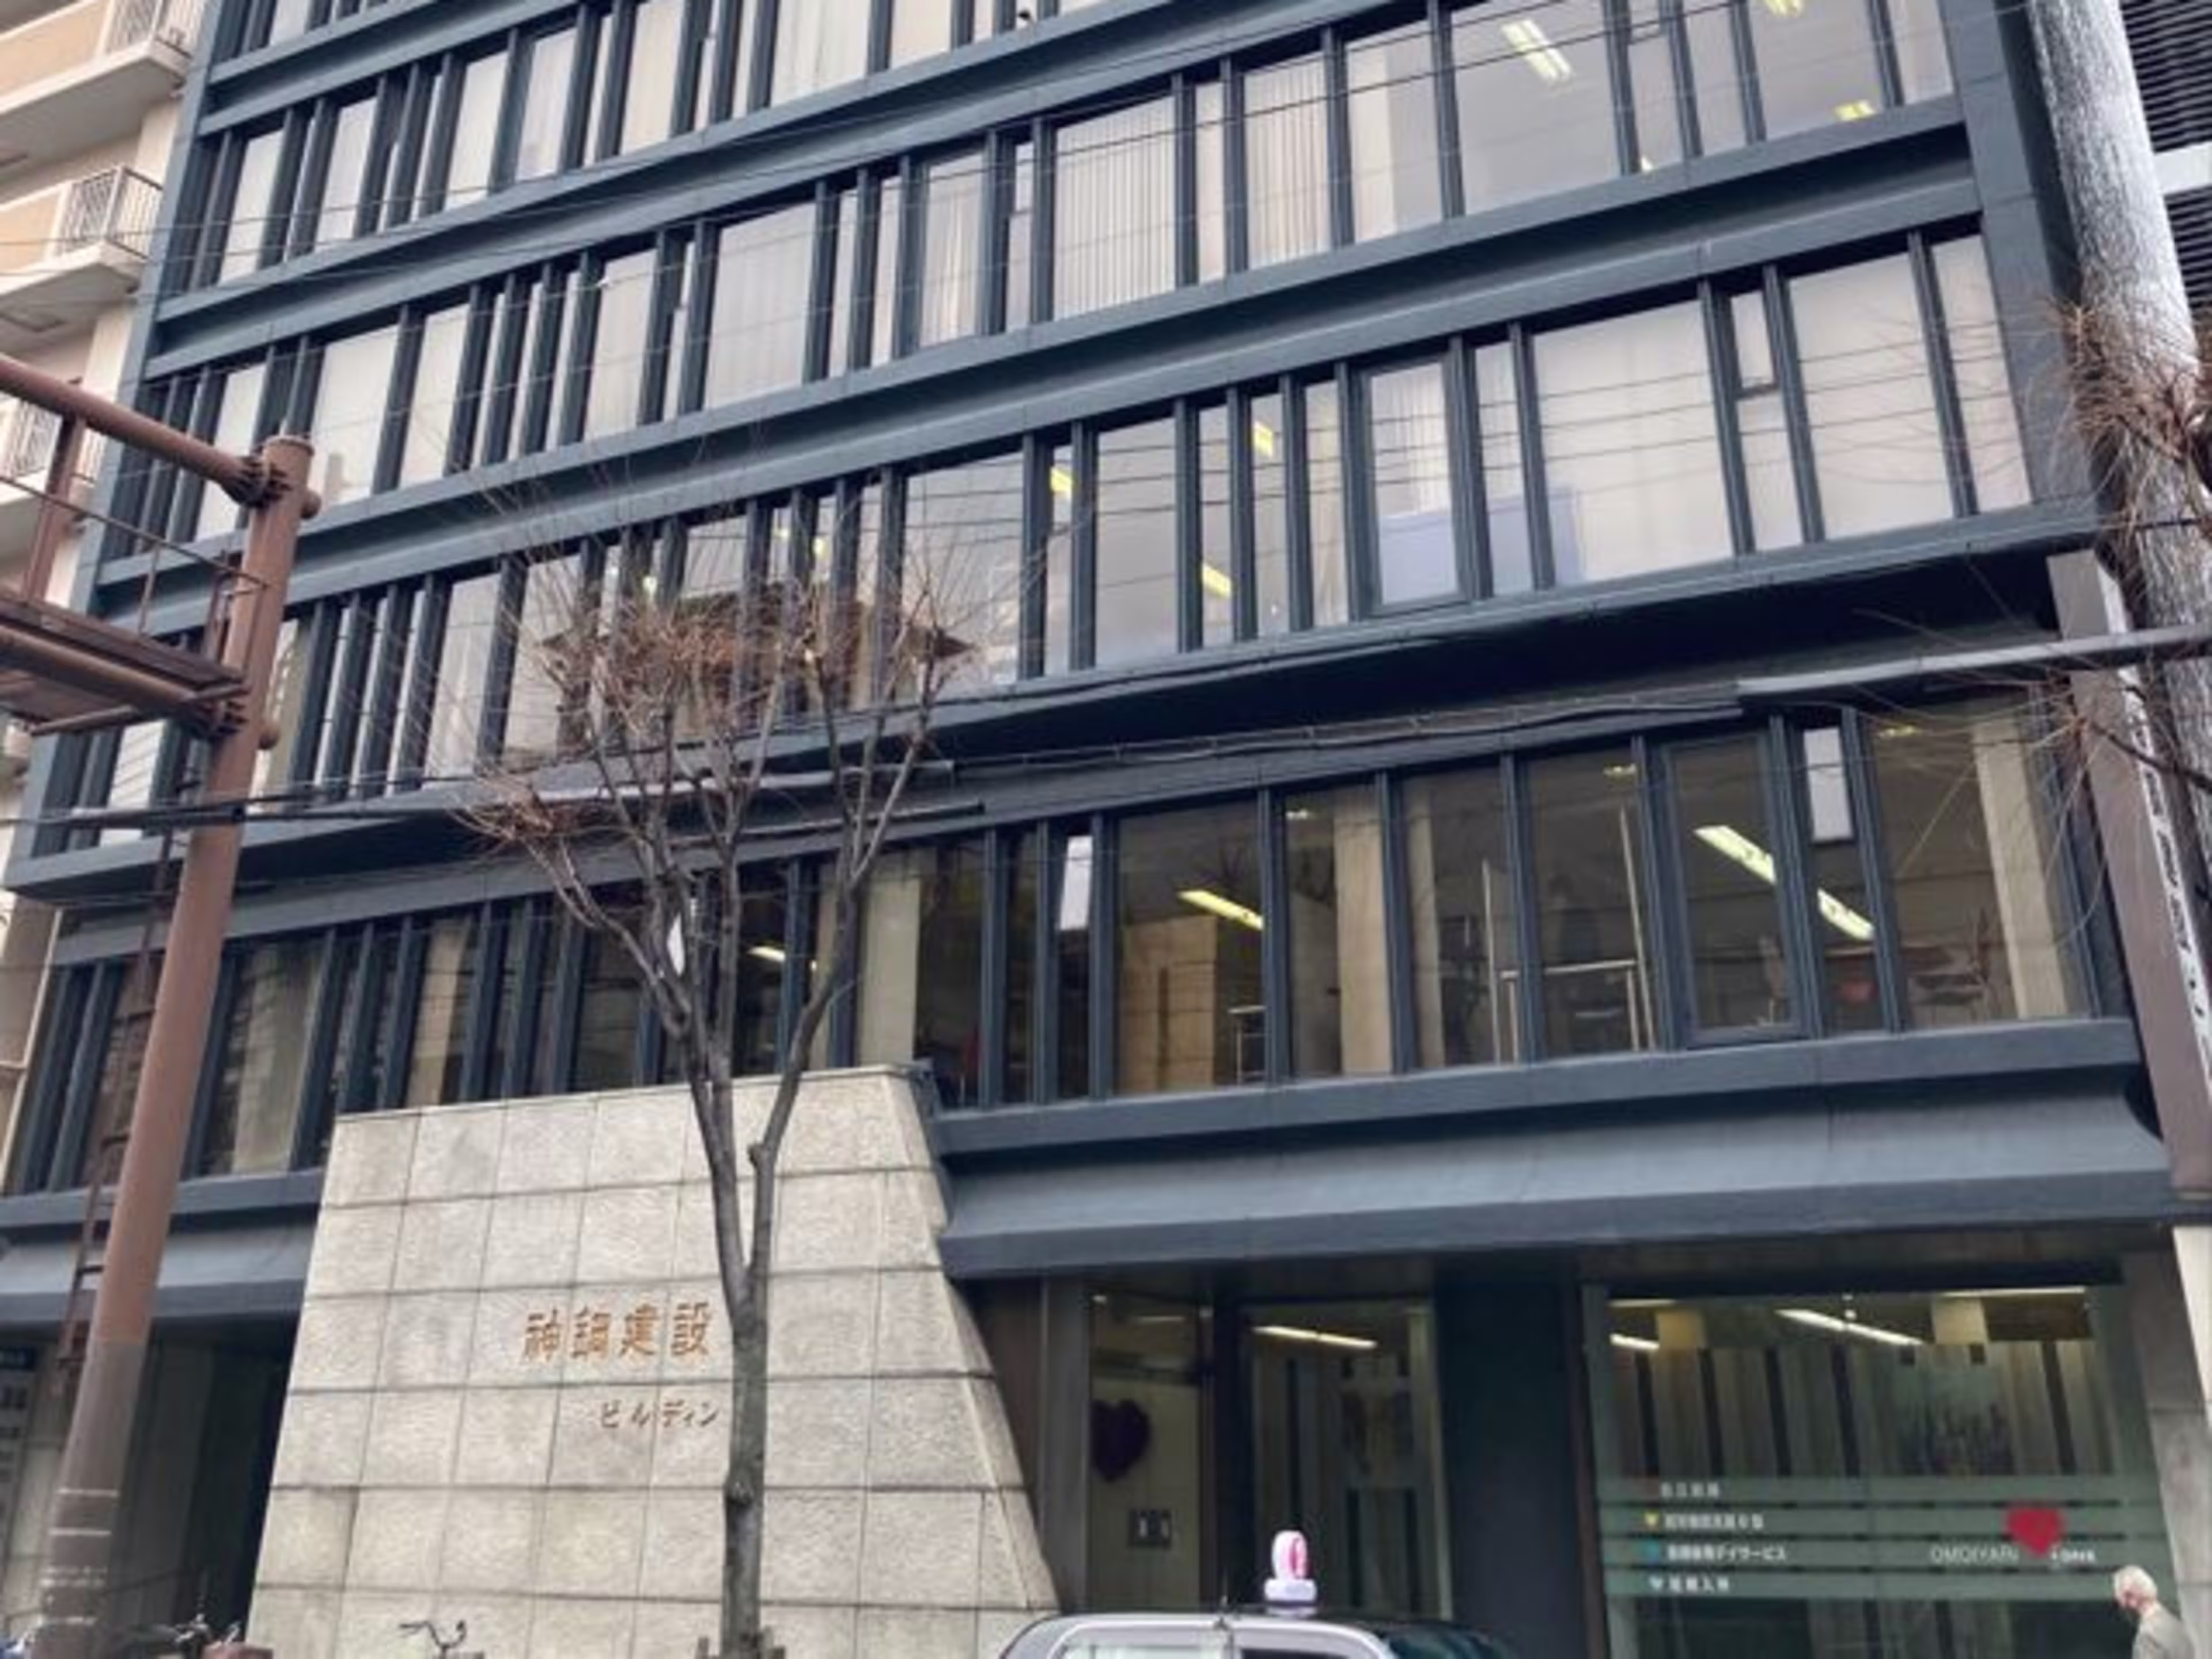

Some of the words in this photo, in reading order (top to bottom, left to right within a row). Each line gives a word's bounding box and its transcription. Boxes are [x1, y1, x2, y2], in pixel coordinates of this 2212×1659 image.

[601, 1400, 719, 1428] ビルディン
